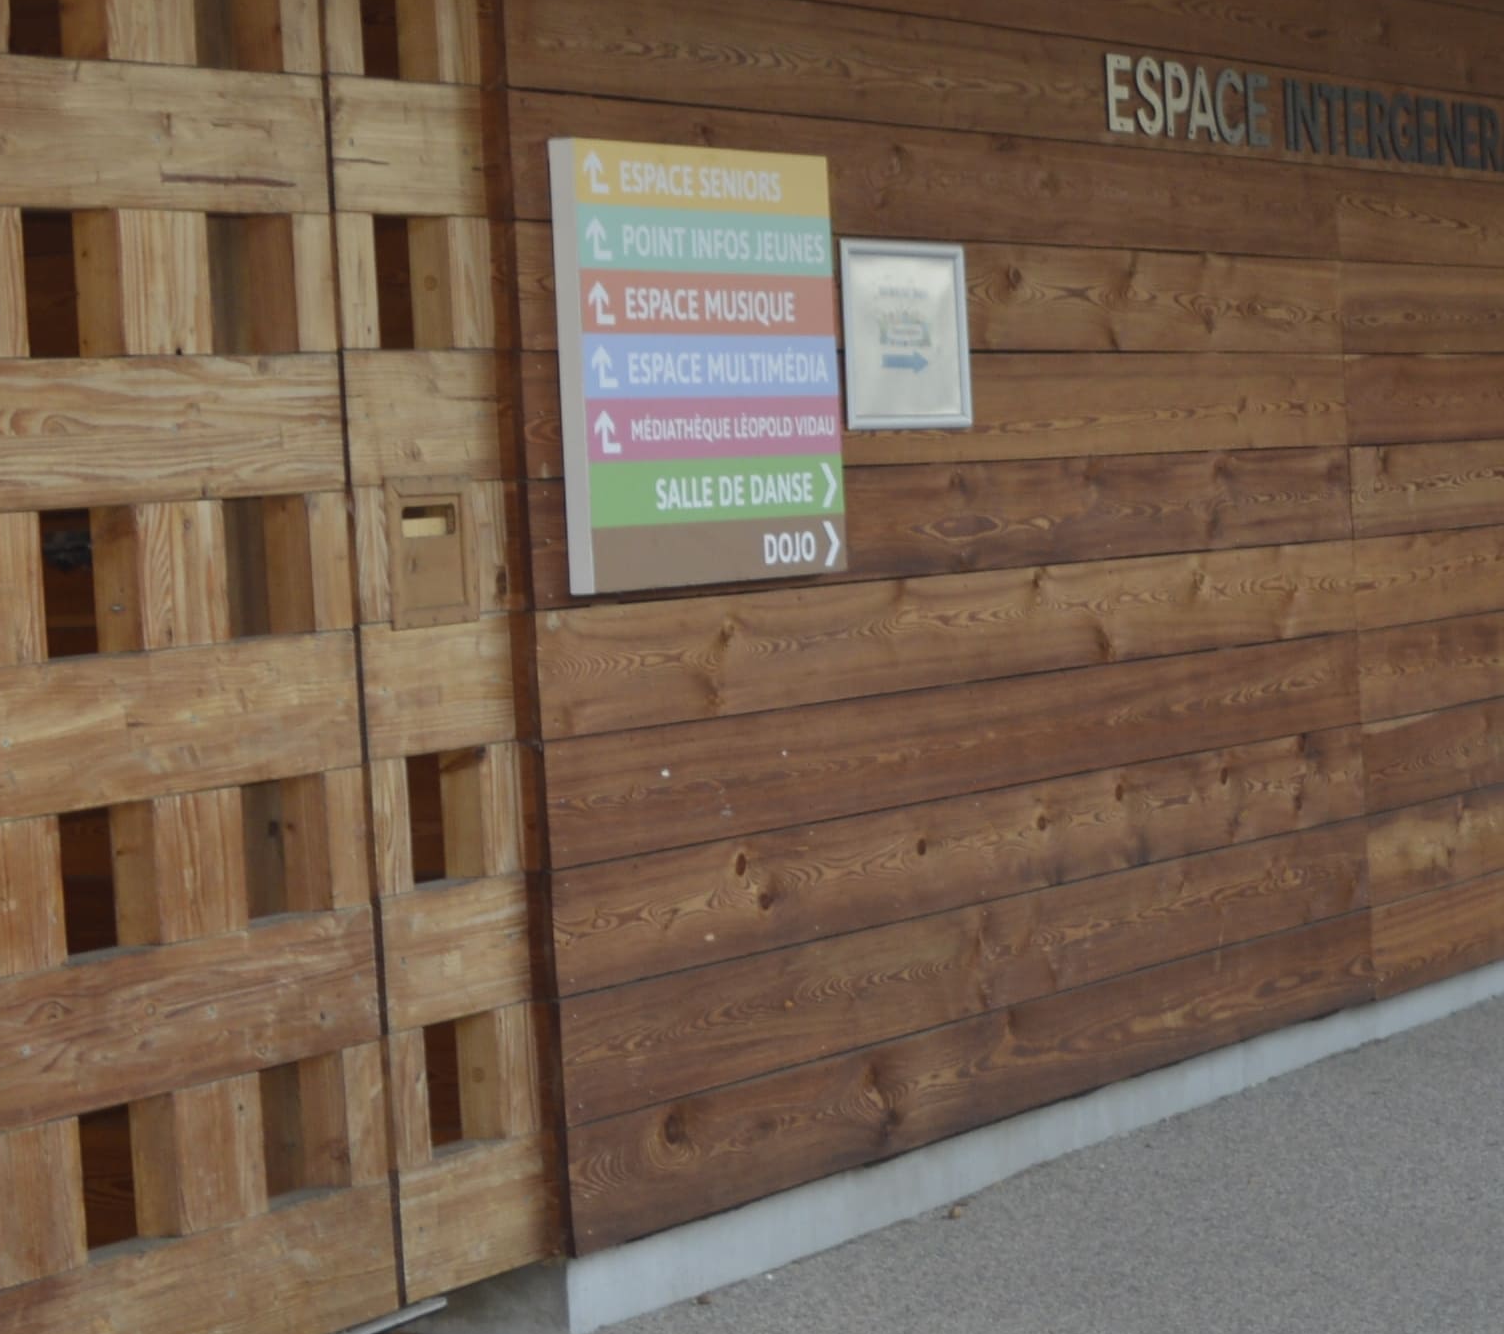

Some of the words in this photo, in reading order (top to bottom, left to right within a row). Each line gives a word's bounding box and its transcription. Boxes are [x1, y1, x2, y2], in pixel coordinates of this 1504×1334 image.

[1105, 53, 1273, 147] ESPACE
[619, 161, 693, 197] ESPACE
[698, 167, 782, 203] SENIORS
[622, 224, 686, 258] POINT
[691, 229, 750, 260] INFOS
[753, 230, 825, 264] JEUNES
[624, 287, 699, 321] ESPACE
[704, 290, 795, 327] MUSIQUE
[627, 351, 701, 384] ESPACE
[707, 347, 829, 384] MULTIMÉDIA
[630, 412, 732, 443] MÉDIATHÈQUE
[796, 415, 835, 437] VIDAU
[655, 476, 712, 510] SALLE
[718, 475, 745, 506] DE
[750, 471, 813, 505] DANSE
[763, 530, 816, 565] DOJO
